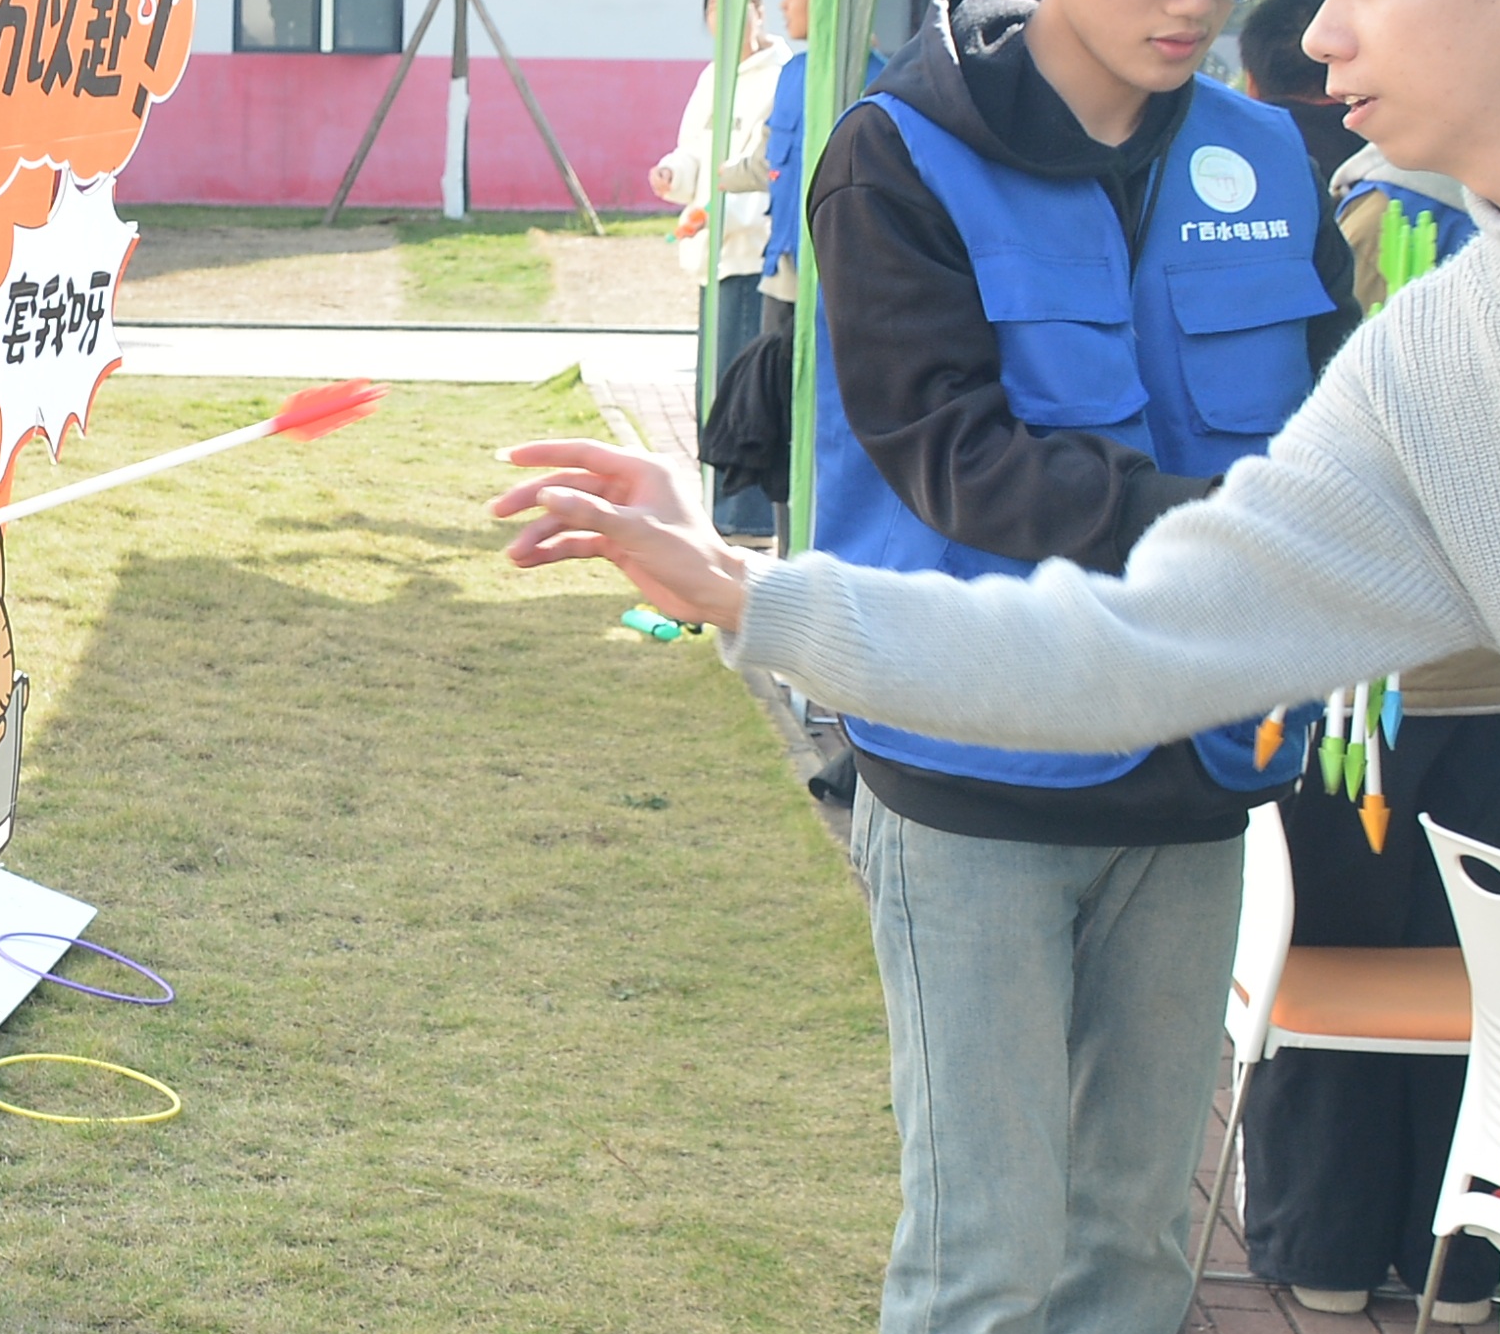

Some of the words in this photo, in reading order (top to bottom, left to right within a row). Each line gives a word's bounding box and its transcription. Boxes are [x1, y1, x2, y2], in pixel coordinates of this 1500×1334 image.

[1181, 219, 1290, 242] 广西水电易班
[2, 271, 111, 364] 套我呀
